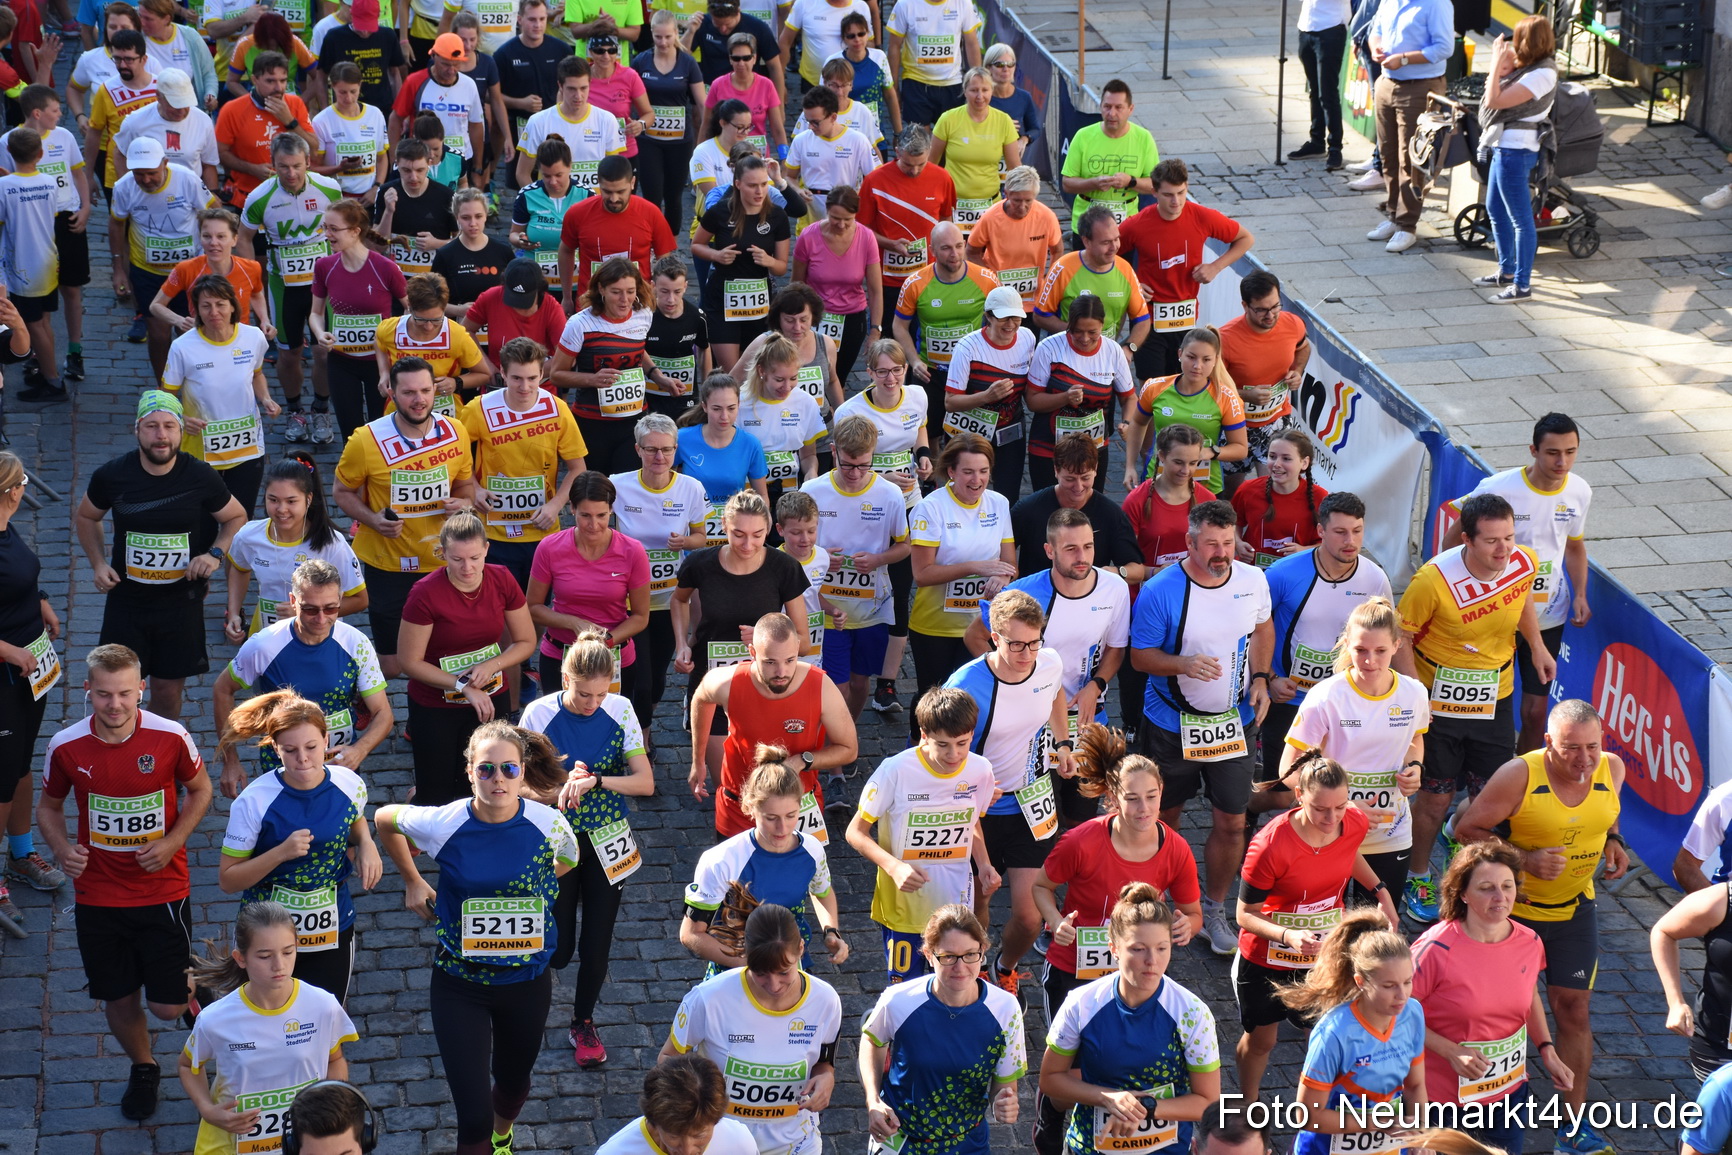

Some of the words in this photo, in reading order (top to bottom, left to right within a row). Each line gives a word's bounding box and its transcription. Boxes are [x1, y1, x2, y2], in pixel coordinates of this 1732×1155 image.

[478, 3, 512, 11] BOCK
[481, 14, 509, 24] 5282
[918, 35, 954, 44] BOCK
[921, 46, 950, 56] 5238
[337, 142, 375, 154] BOCK
[8, 184, 18, 192] 20.
[957, 199, 992, 210] BOCK
[147, 236, 190, 248] BOCK
[151, 250, 189, 262] 5243
[998, 269, 1038, 280] BOCK
[727, 282, 766, 292] BOCK
[730, 293, 766, 307] 5118
[731, 309, 764, 317] MARLENE
[1159, 303, 1192, 318] 5186
[335, 316, 377, 327] BOCK
[338, 330, 376, 343] 5062
[928, 325, 973, 338] BOCK
[397, 352, 420, 360] MAX
[424, 351, 450, 360] BÖGL
[605, 385, 641, 402] 5086
[615, 404, 637, 412] ANITA
[207, 416, 254, 433] BOCK
[949, 415, 988, 436] 5084
[1060, 412, 1103, 427] BOCK
[210, 431, 251, 450] 5273
[492, 431, 522, 446] MAX
[527, 423, 560, 438] BÖGL
[430, 447, 463, 466] BÖGL
[396, 469, 446, 484] BOCK
[491, 478, 540, 490] BOCK
[398, 485, 443, 501] 5101
[404, 503, 438, 512] SIEMON
[493, 494, 540, 508] 5100
[1555, 504, 1566, 512] 20
[502, 512, 530, 520] JONAS
[912, 519, 928, 531] 20
[131, 535, 183, 547] BOCK
[133, 550, 182, 567] 5277
[141, 571, 171, 580] MARC
[652, 563, 674, 578] 69
[1462, 603, 1499, 624] MAX
[1503, 579, 1530, 604] BÖG
[446, 648, 497, 672] BOCK
[1441, 669, 1494, 683] BOCK
[1439, 686, 1490, 702] 5095
[1388, 707, 1401, 715] 20
[1441, 704, 1484, 714] FLORIAN
[1597, 650, 1693, 793] Hervis
[1190, 723, 1236, 745] 5049
[1190, 743, 1240, 757] BERNHARD
[956, 783, 967, 792] 20
[95, 793, 158, 812] BOCK
[97, 813, 157, 833] 5188
[912, 811, 970, 825] BOCK
[105, 836, 148, 845] TOBIAS
[911, 827, 964, 846] 5227
[918, 850, 953, 858] PHILIP
[612, 859, 632, 875] ANNA
[276, 890, 332, 910] BOCK
[469, 900, 536, 912] BOCK
[472, 917, 534, 936] 5213
[1276, 912, 1338, 929] BOCK
[473, 940, 532, 949] JOHANNA
[887, 940, 912, 971] 10
[285, 1022, 300, 1032] 20
[789, 1020, 804, 1031] 20
[286, 1029, 318, 1040] Neumarkter
[286, 1036, 312, 1046] Stadtlauf
[732, 1062, 806, 1080] BOCK
[1477, 1075, 1514, 1092] STILLA
[730, 1082, 795, 1103] 5064
[733, 1106, 785, 1117] KRISTIN
[1112, 1136, 1161, 1149] CARINA
